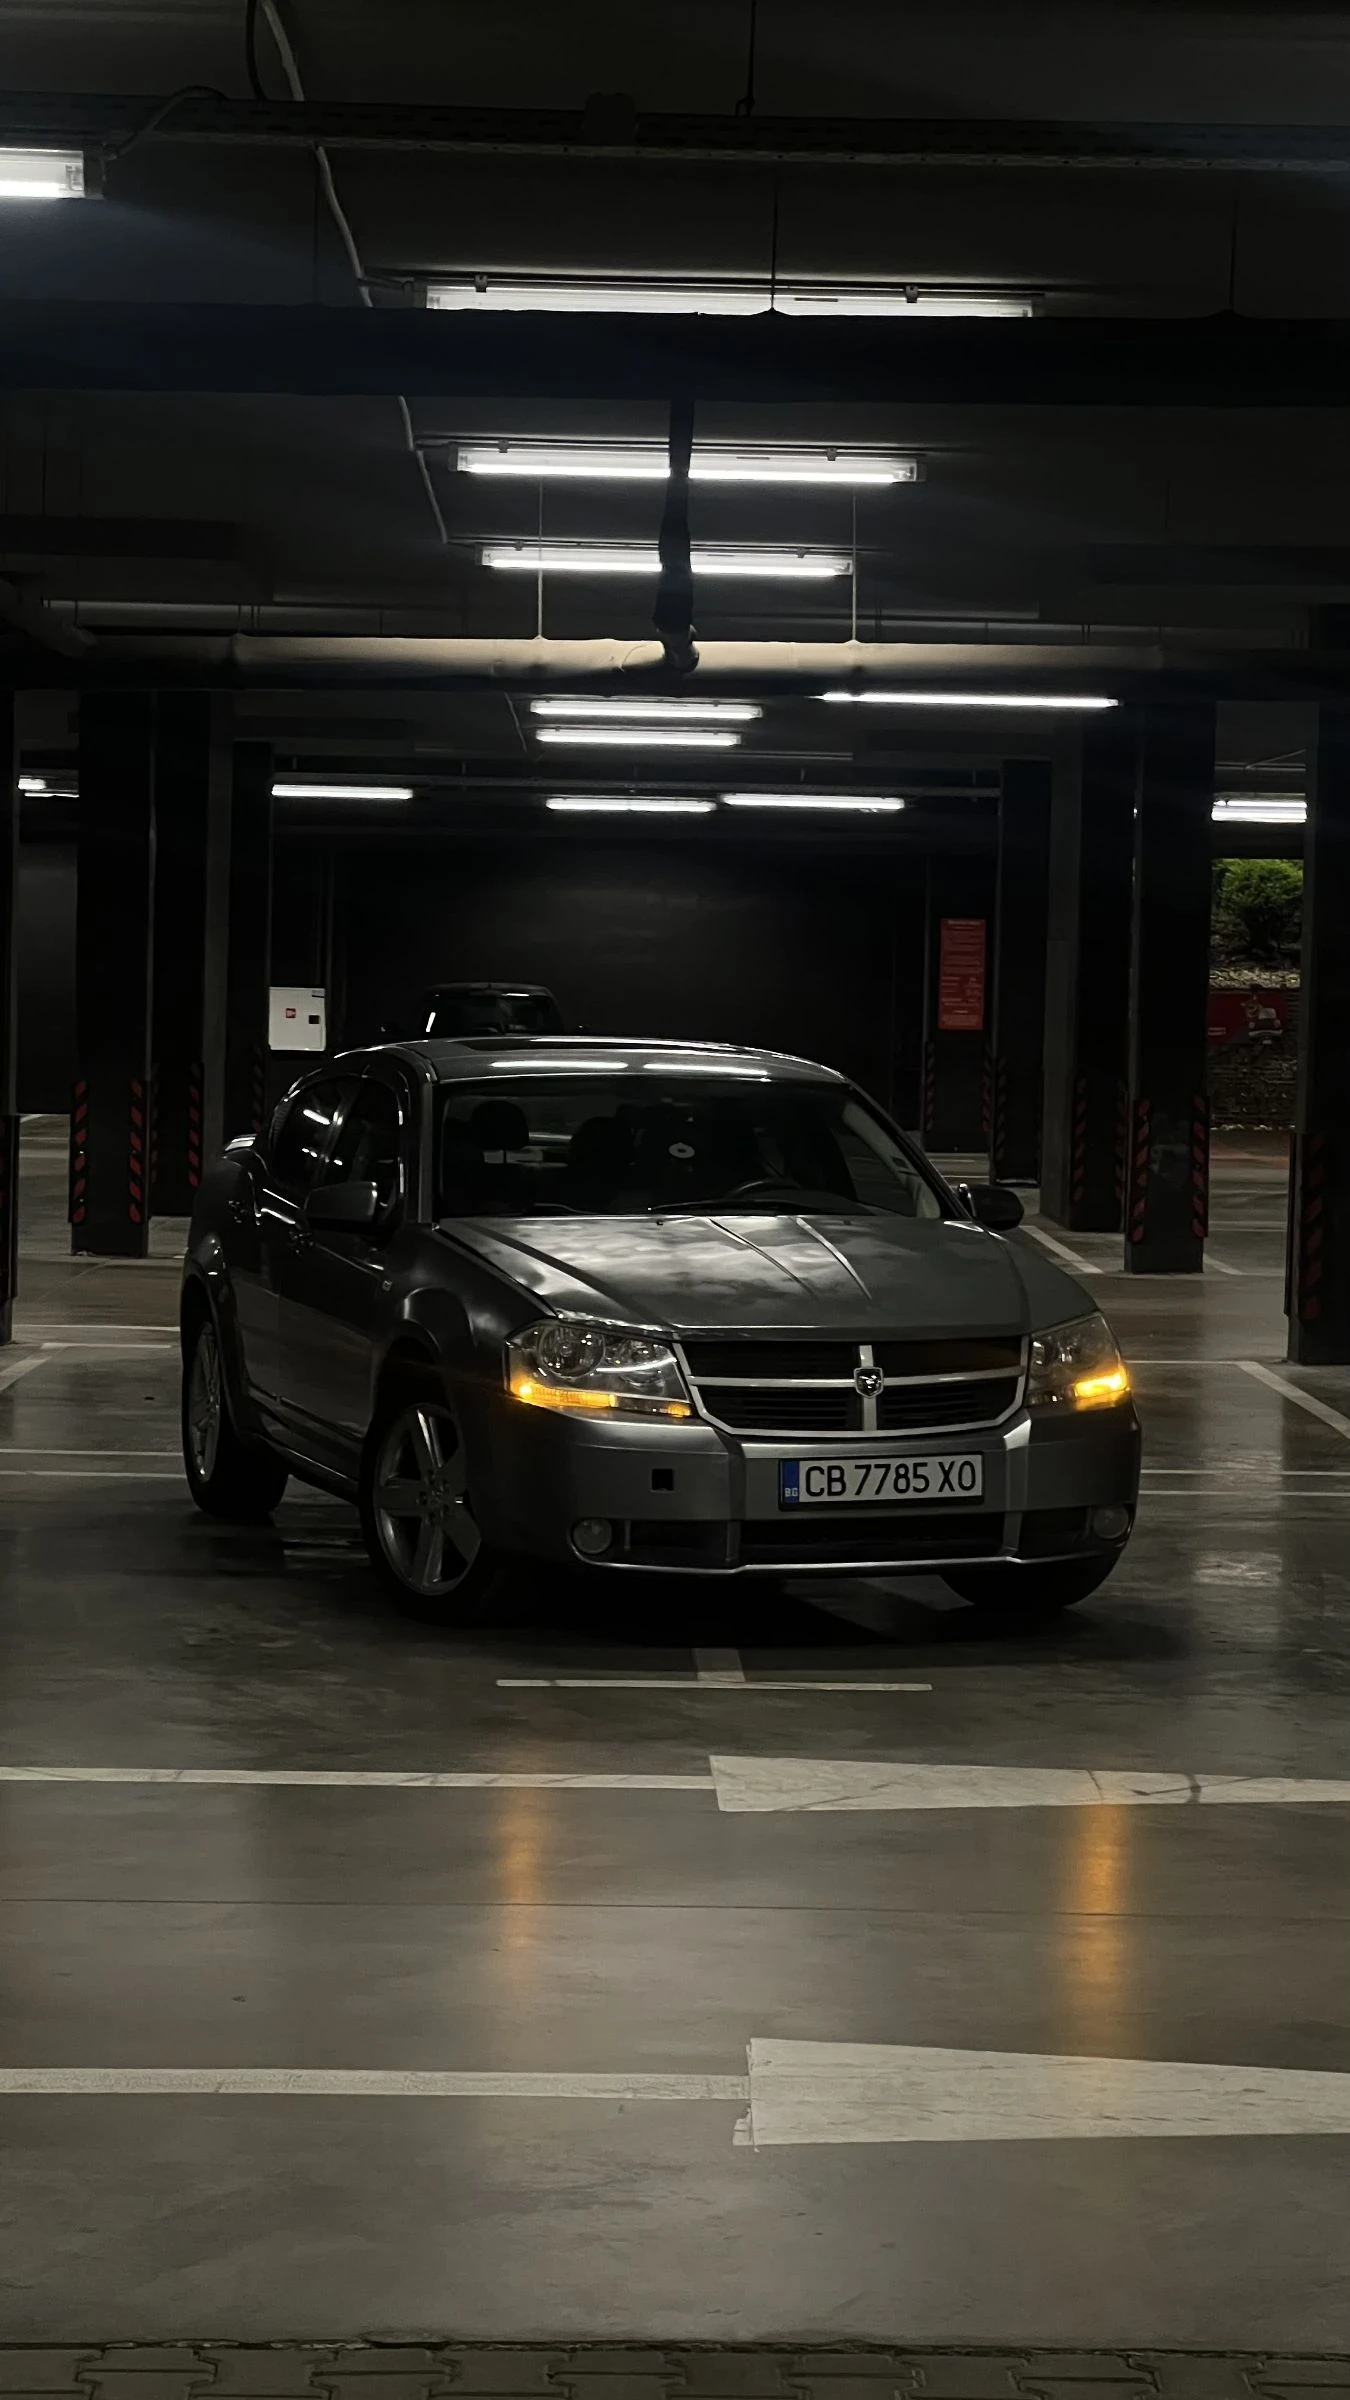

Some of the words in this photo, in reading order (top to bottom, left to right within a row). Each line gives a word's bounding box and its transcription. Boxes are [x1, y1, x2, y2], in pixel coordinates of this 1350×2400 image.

[805, 1465, 847, 1497] CB
[854, 1462, 930, 1495] 7785
[937, 1460, 976, 1493] XO
[784, 1487, 798, 1497] BG
